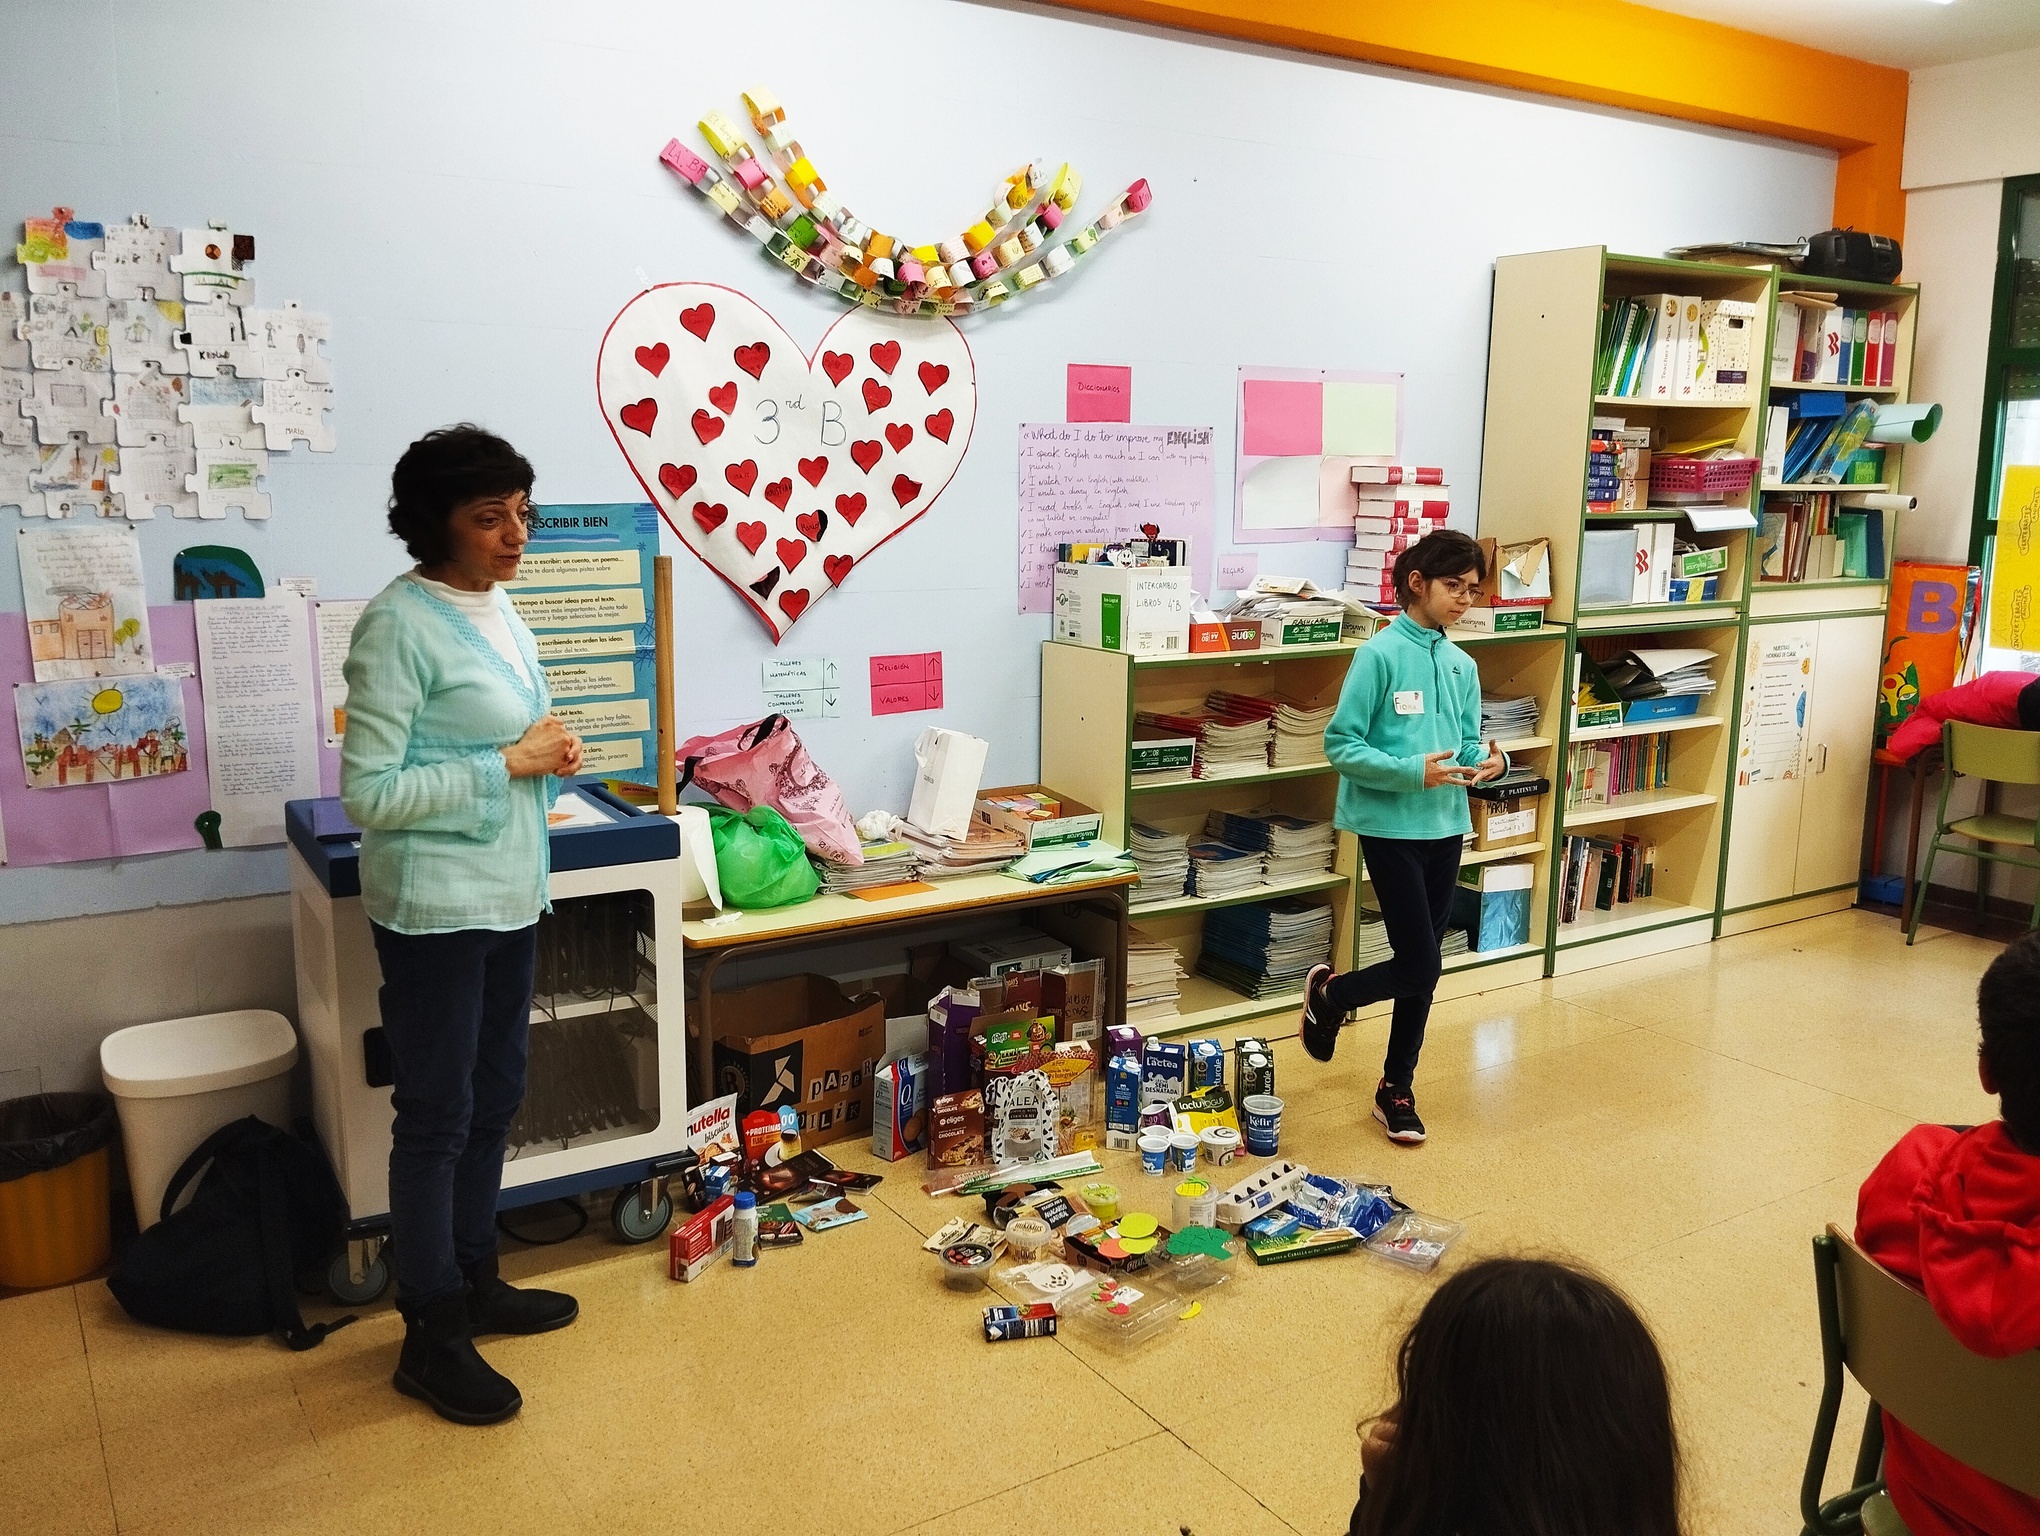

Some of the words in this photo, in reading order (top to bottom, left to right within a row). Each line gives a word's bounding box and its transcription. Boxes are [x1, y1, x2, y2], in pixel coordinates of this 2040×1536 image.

[1661, 344, 1669, 379] Teacher's
[821, 401, 846, 446] B
[285, 427, 304, 435] MARIO
[1059, 430, 1071, 440] do
[1073, 429, 1081, 441] I
[1084, 430, 1096, 441] do
[1099, 429, 1113, 441] to
[1116, 431, 1150, 452] improve
[1027, 447, 1033, 456] I
[1036, 446, 1060, 461] speak
[1064, 448, 1089, 467] English
[1105, 450, 1125, 460] much
[1139, 451, 1145, 460] I
[1028, 476, 1036, 486] I
[1039, 475, 1060, 485] watch
[1088, 474, 1108, 490] English
[1029, 488, 1035, 497] I
[1038, 488, 1056, 496] write
[1069, 486, 1089, 504] diary
[1105, 487, 1128, 500] English
[1028, 502, 1034, 511] I
[1038, 501, 1057, 512] read
[1062, 501, 1082, 511] books
[1128, 500, 1141, 508] and
[584, 516, 608, 527] BIEN
[1047, 513, 1065, 521] tablet
[1080, 512, 1109, 526] computer
[1028, 530, 1033, 539] I
[1036, 527, 1052, 538] make
[1054, 529, 1074, 542] copies
[1085, 525, 1109, 537] writings
[1114, 527, 1130, 539] from
[2021, 506, 2031, 552] VERTEBRATES
[1028, 544, 1034, 554] I
[556, 567, 579, 575] algunas
[579, 566, 595, 574] pistas
[1026, 561, 1032, 571] I
[1056, 566, 1079, 575] NAVIGATOR
[1222, 566, 1245, 576] REGLAS
[1026, 578, 1032, 588] I
[1136, 581, 1177, 591] INTERCAMBIO
[1136, 598, 1161, 608] LIBROS
[1906, 580, 1958, 634] B
[2022, 586, 2030, 618] ANIMALS
[552, 613, 568, 622] luego
[2013, 588, 2023, 648] INVERTEBRATES
[1461, 619, 1486, 627] NAVIGATOR
[1312, 631, 1336, 639] NAVIGATOR
[538, 647, 563, 655] borrador
[562, 668, 588, 676] borrador.
[770, 670, 807, 678] MATEMÁTICAS
[573, 684, 586, 692] algo
[587, 682, 622, 690] importante...
[880, 696, 909, 704] VALORES
[1395, 697, 1417, 710] FIONA
[559, 709, 568, 717] del
[585, 717, 595, 725] que
[605, 714, 615, 723] hay
[574, 723, 591, 732] signos
[607, 753, 629, 761] procura
[1162, 755, 1189, 763] NAVIGATOR
[1509, 785, 1538, 795] PLATINUM
[1067, 831, 1095, 839] NAVIGATOR
[1145, 1087, 1178, 1095] DESNATADA
[1010, 1096, 1039, 1106] ALEA
[687, 1107, 730, 1138] nutella
[946, 1116, 964, 1124] eliges
[1249, 1115, 1272, 1126] Kéfir
[704, 1120, 730, 1144] biscuits
[939, 1130, 965, 1139] CHOCOLATE
